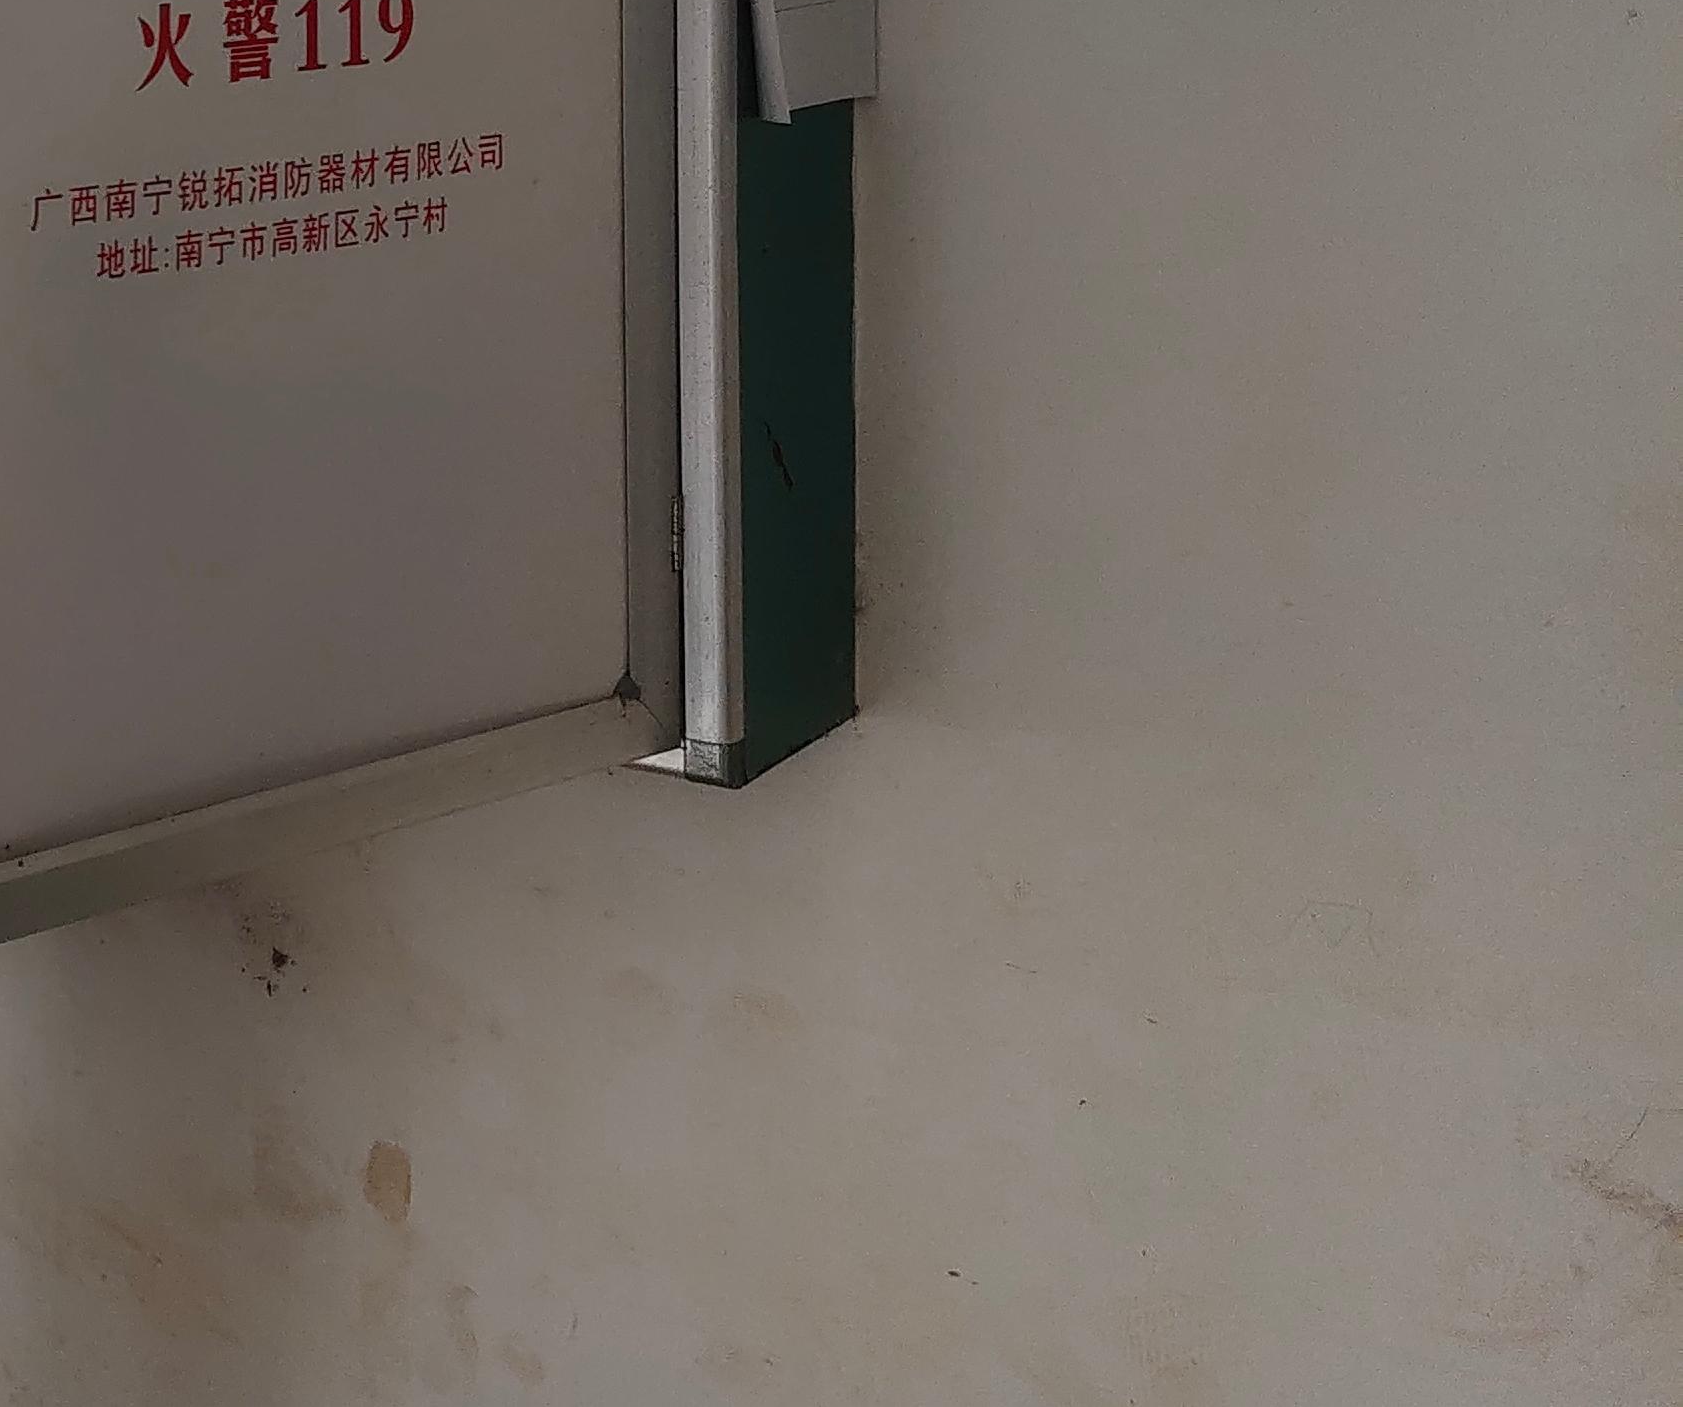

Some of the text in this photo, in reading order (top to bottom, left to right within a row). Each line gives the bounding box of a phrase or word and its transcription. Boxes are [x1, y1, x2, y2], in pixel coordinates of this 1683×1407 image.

[31, 133, 505, 232] 广西南宁锐拓消防器材有限公司
[96, 197, 449, 280] 地址:南宁市高新区永宁村
